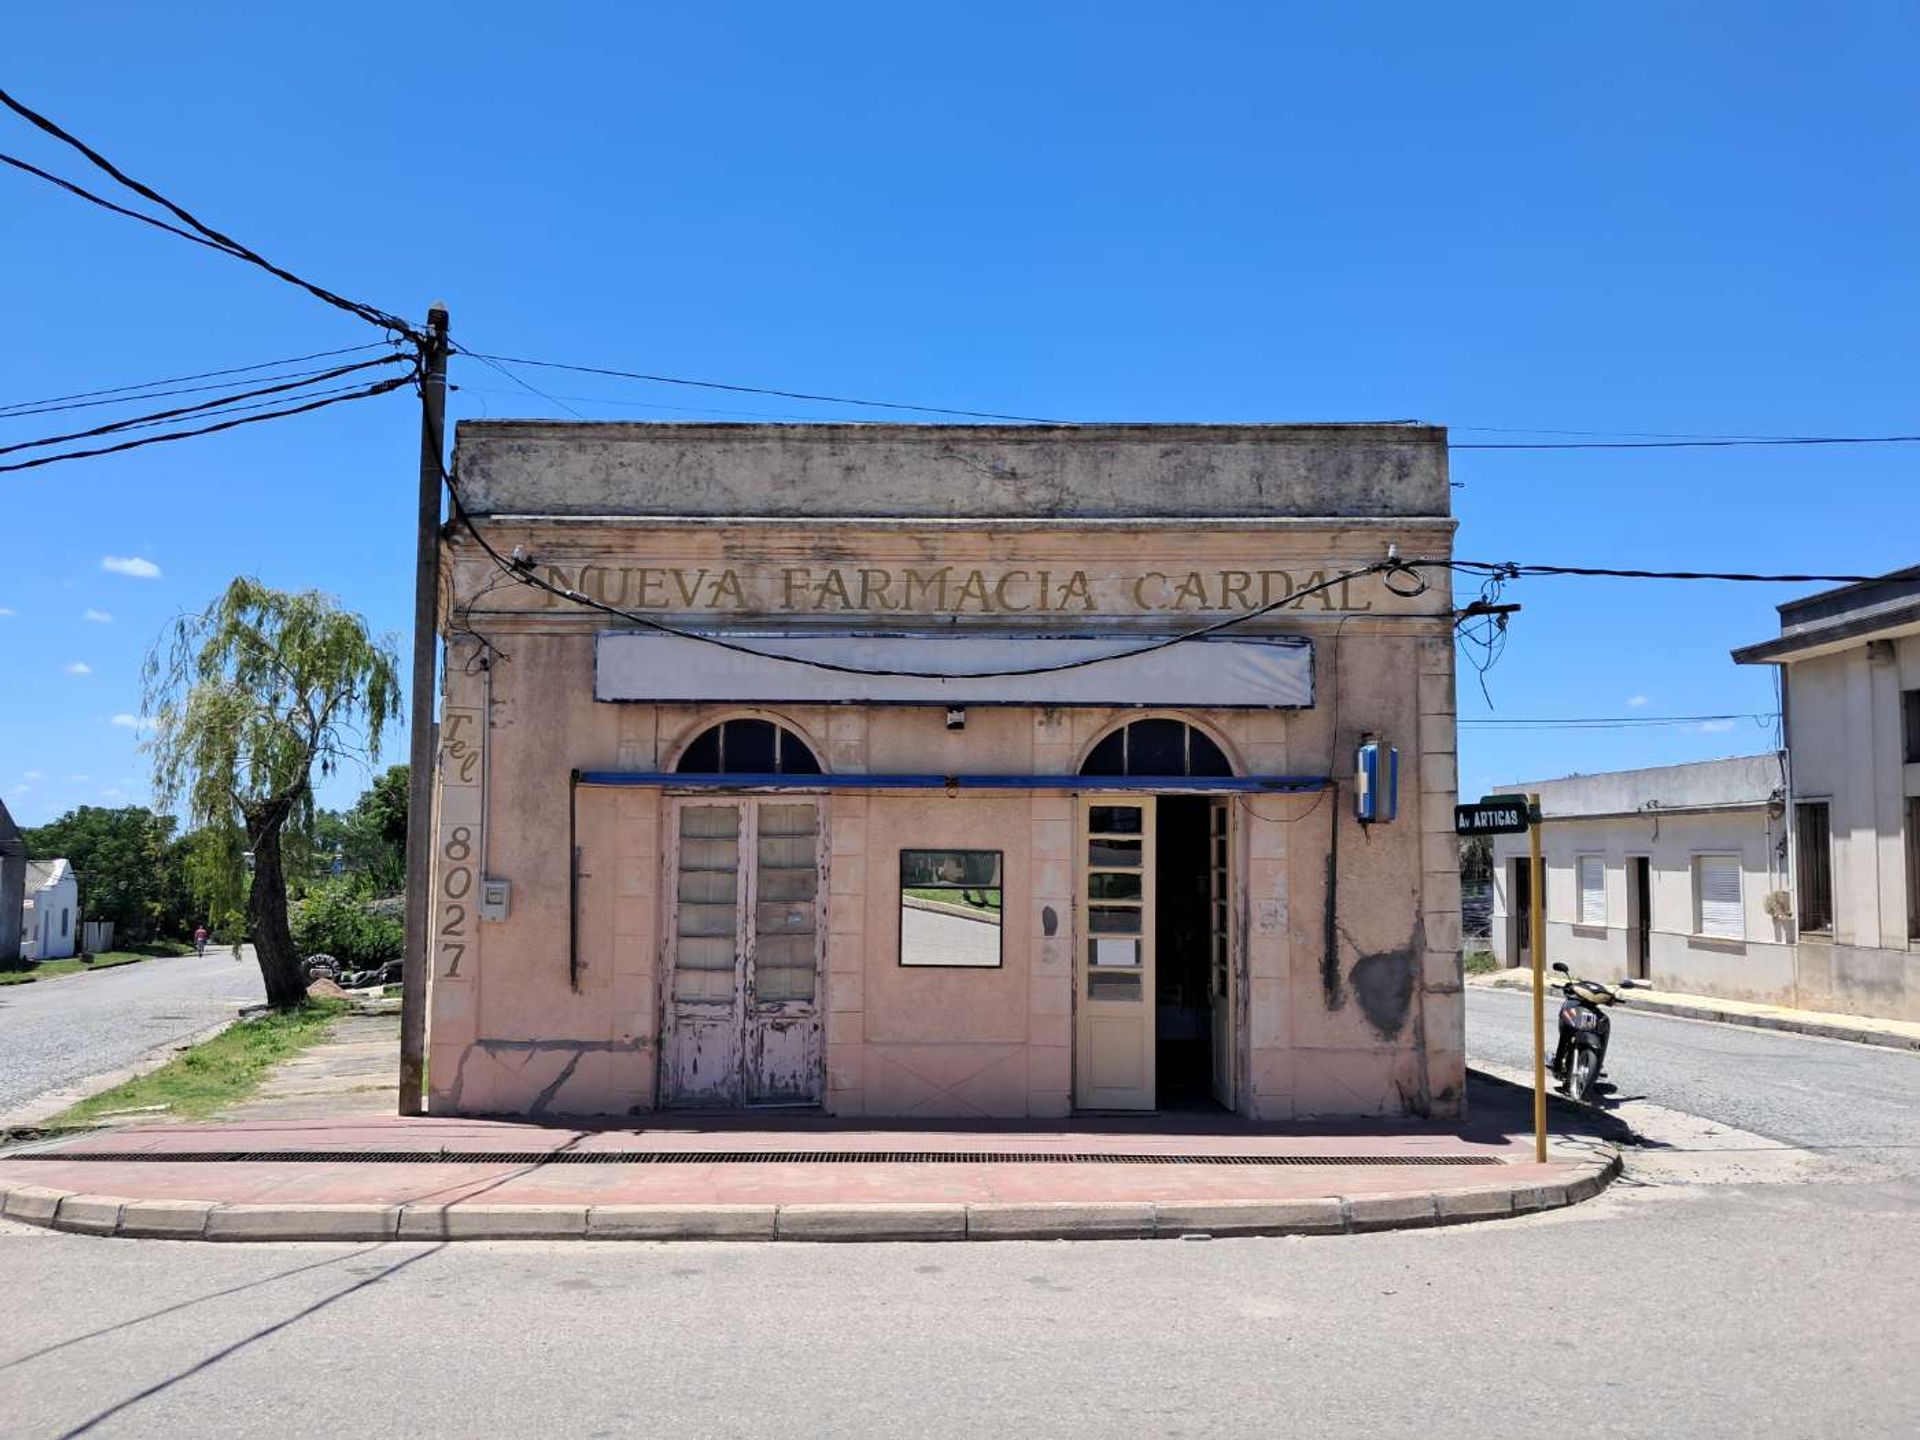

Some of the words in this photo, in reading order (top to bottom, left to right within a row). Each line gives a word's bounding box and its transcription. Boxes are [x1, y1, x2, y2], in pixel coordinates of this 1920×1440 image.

[543, 564, 744, 609] NUEVA
[780, 566, 1099, 612] FARMACIA
[1133, 569, 1372, 611] CARDAL
[445, 714, 479, 783] Tel
[441, 827, 472, 979] 8027
